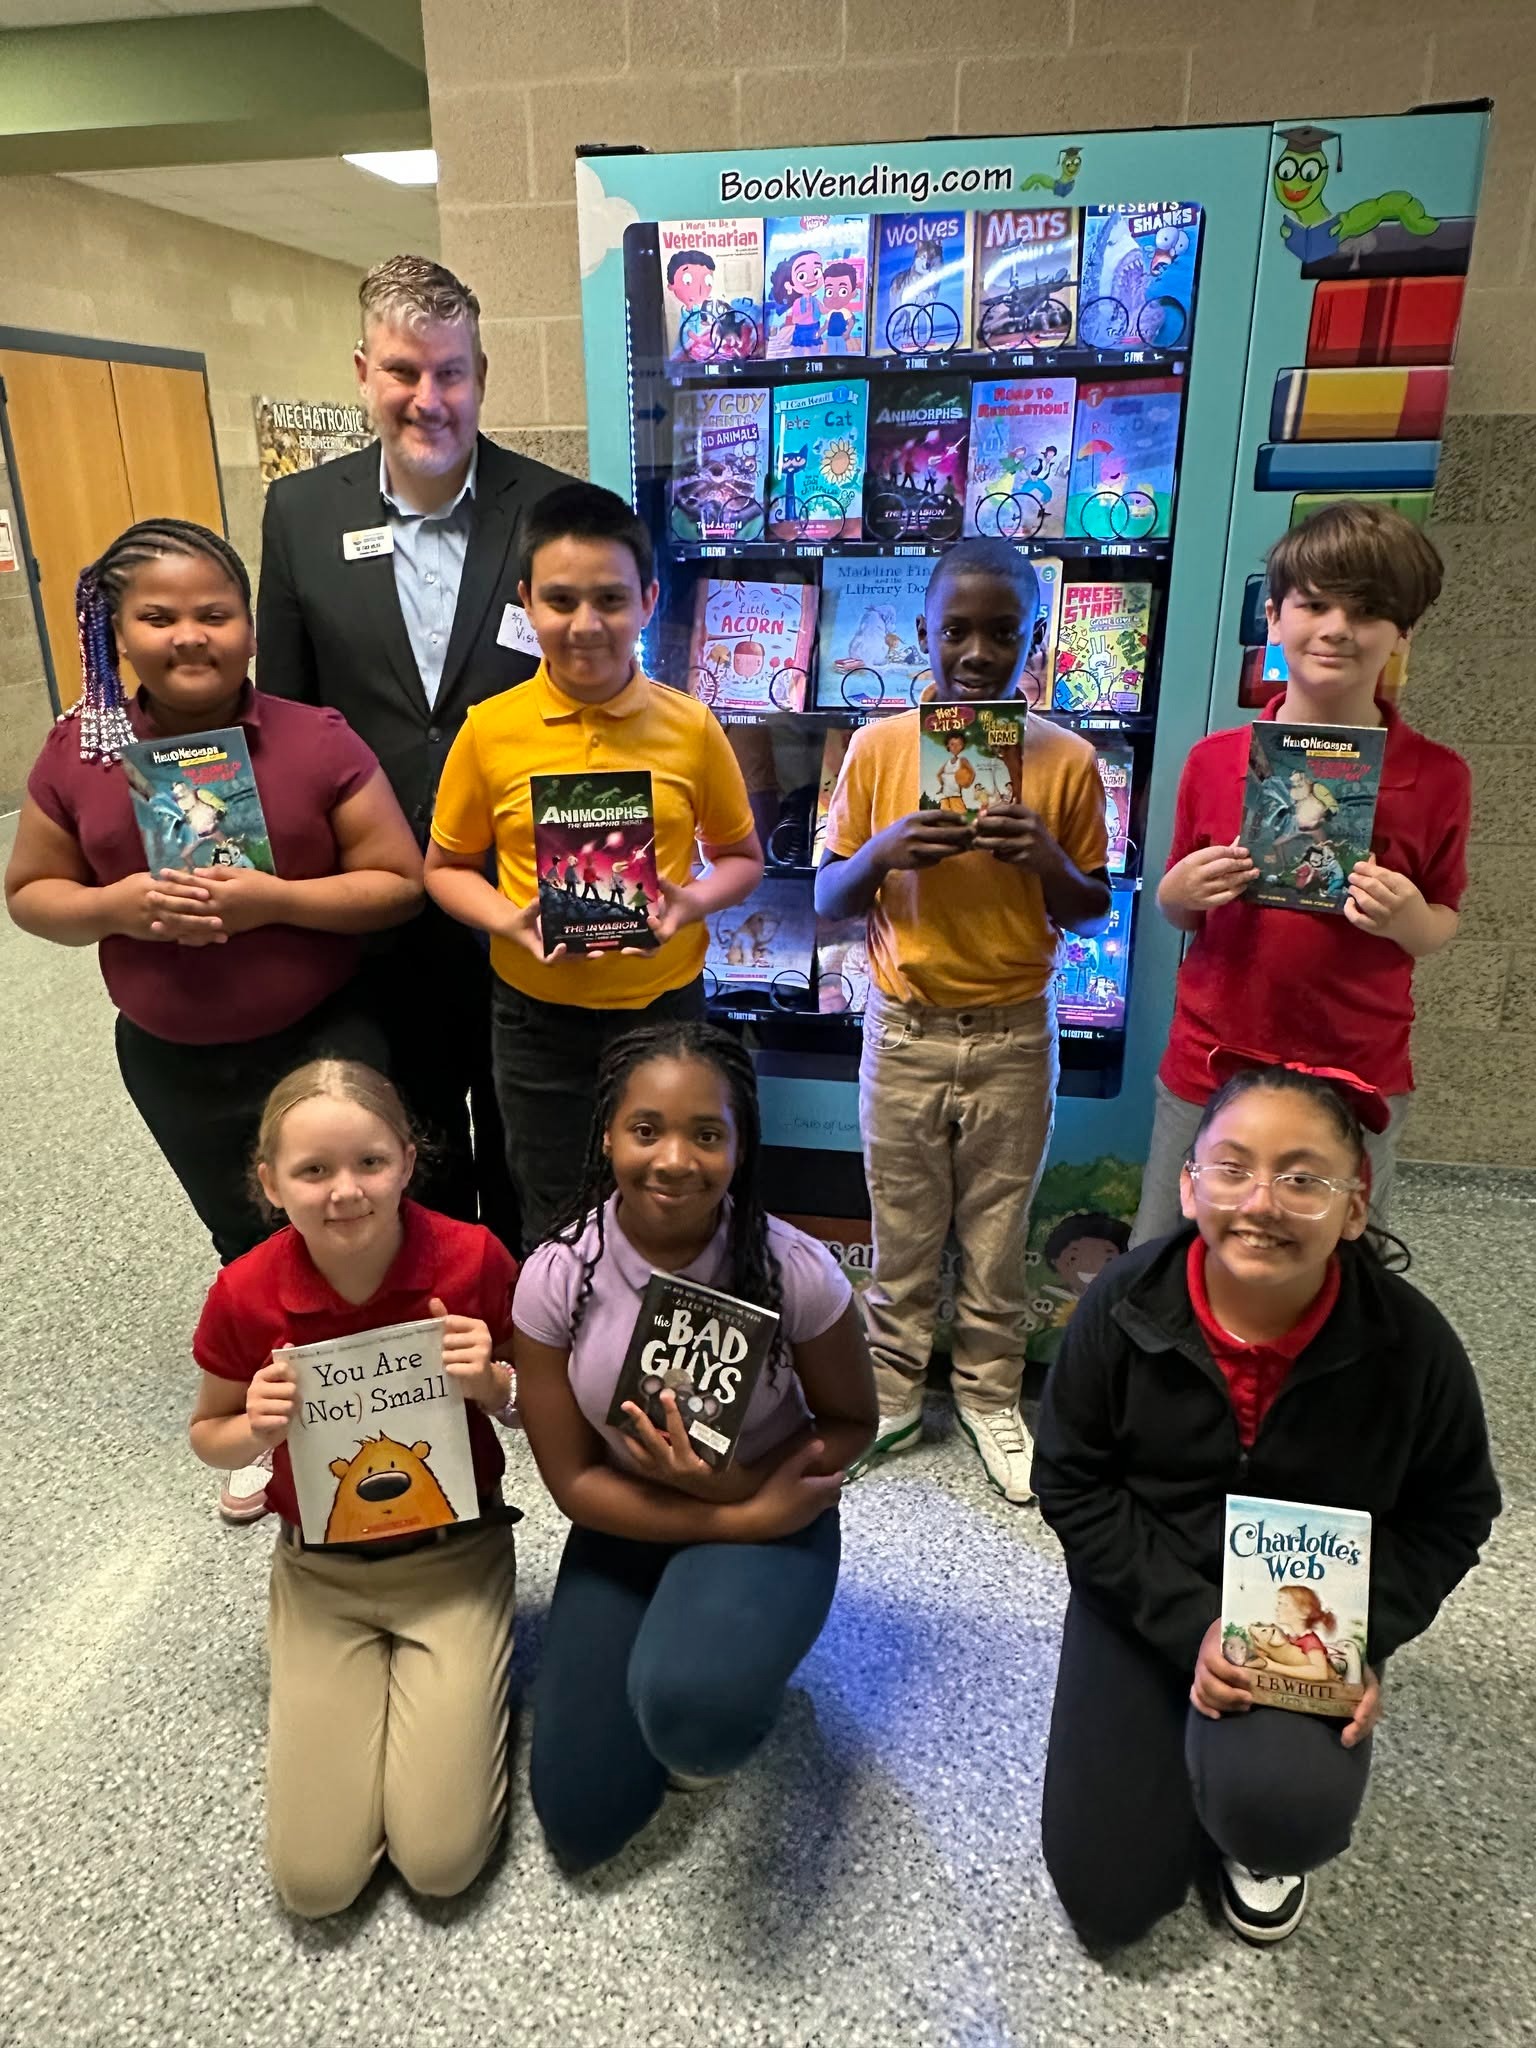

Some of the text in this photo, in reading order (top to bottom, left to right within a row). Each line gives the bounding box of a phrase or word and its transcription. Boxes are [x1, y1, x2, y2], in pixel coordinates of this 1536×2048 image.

[721, 165, 1012, 202] BookVending.com
[983, 211, 1067, 248] Mars
[1133, 208, 1192, 233] SHARKS
[662, 229, 758, 249] Veterinarian
[886, 217, 959, 248] Wolves
[785, 410, 853, 431] ete Cat
[875, 408, 963, 424] ANIMORPHS
[717, 427, 758, 445] ANIMALS
[846, 582, 926, 597] Library Do
[1066, 587, 1123, 605] PRESS
[739, 602, 770, 615] Little
[1064, 598, 1126, 624] START!
[721, 615, 784, 635] ACORN
[989, 731, 1017, 744] NAME
[540, 805, 649, 825] ANIMORPHS
[564, 921, 639, 934] THE INVASION
[654, 1315, 671, 1328] the
[668, 1309, 749, 1364] BAD
[313, 1352, 422, 1388] You Are
[640, 1340, 742, 1404] GUYS
[301, 1375, 449, 1431] (Not) Small
[1229, 1519, 1361, 1566] Charlotte's
[1262, 1553, 1326, 1583] Web
